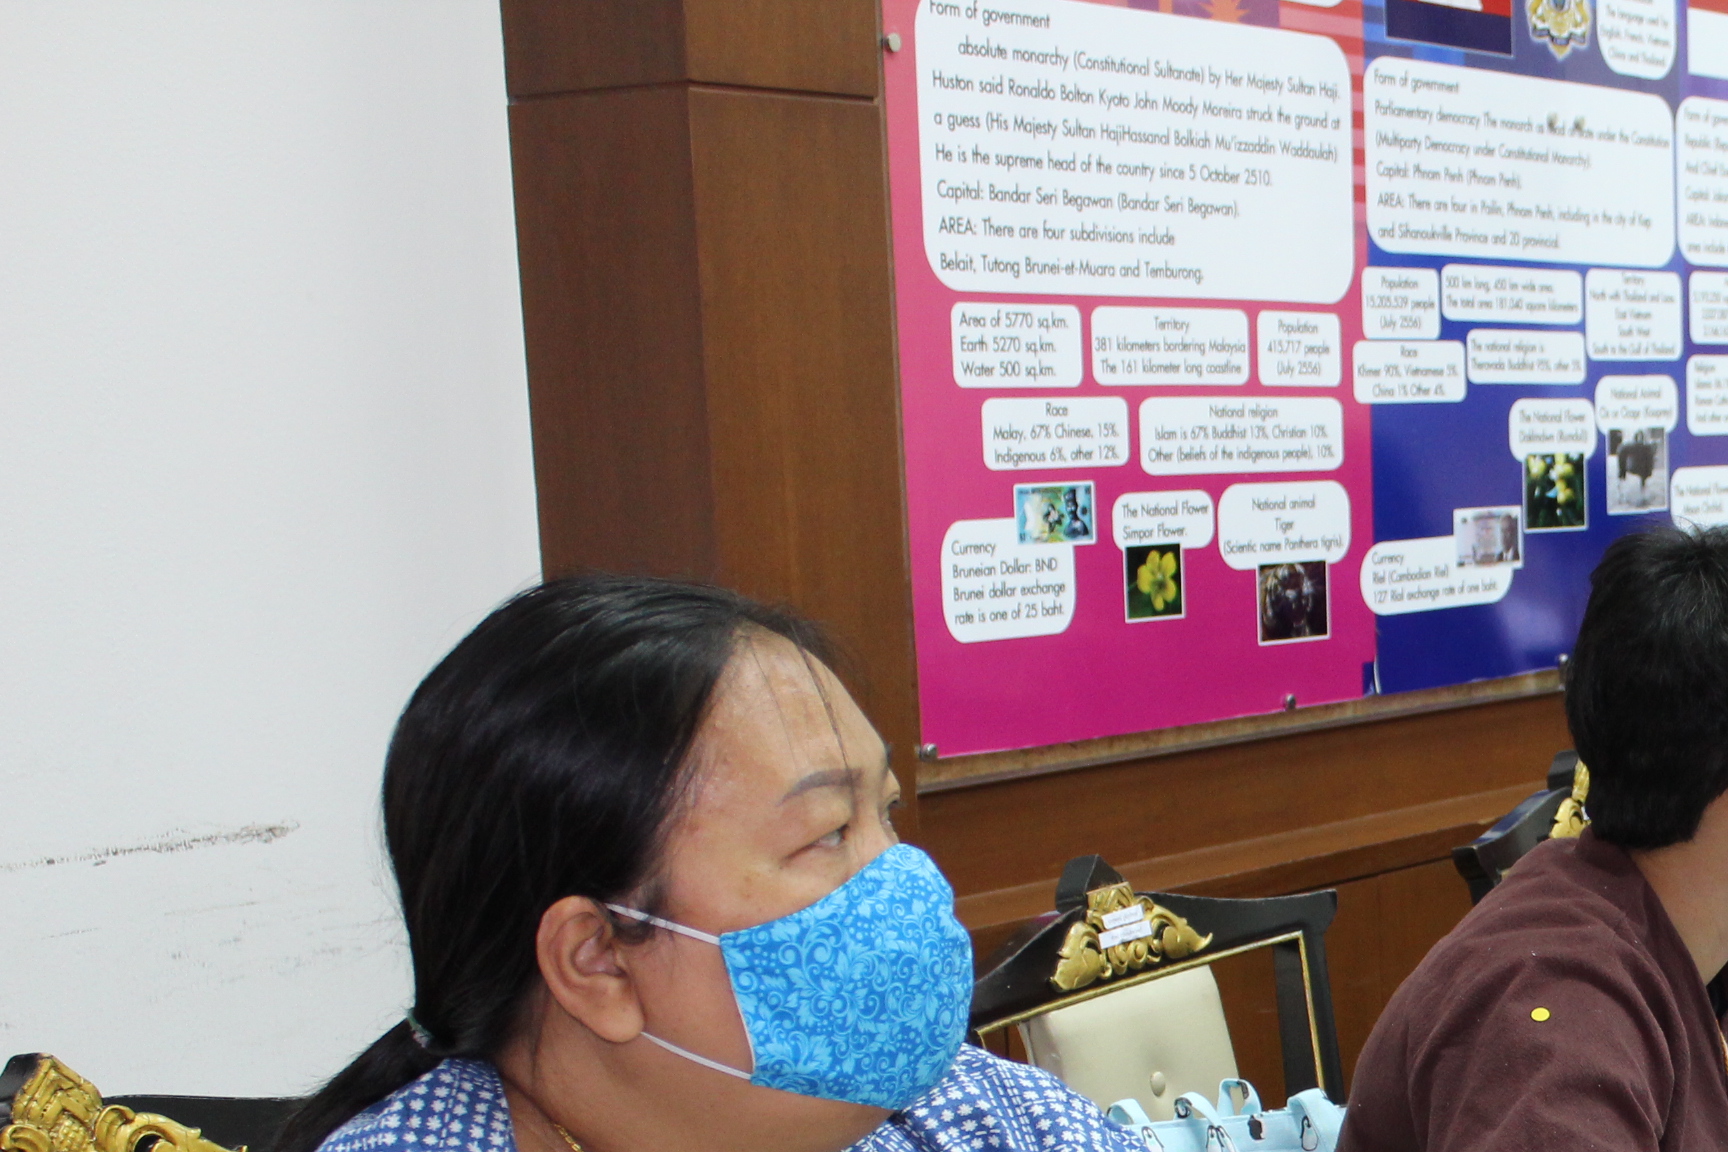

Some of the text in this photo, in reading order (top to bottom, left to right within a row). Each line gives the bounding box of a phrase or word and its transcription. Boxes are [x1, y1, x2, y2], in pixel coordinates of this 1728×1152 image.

[964, 0, 977, 19] of
[981, 8, 1050, 27] government
[957, 35, 1007, 59] absolute
[1011, 46, 1068, 70] monarchy
[1072, 50, 1150, 75] (Constitutional
[1153, 59, 1205, 83] Sultanate)
[1207, 65, 1221, 88] by
[1224, 69, 1242, 86] Her
[1245, 73, 1283, 94] Majesty
[1286, 76, 1316, 95] Sultan
[931, 69, 974, 90] Huston
[978, 74, 1004, 94] said
[1007, 77, 1056, 99] Ronaldo
[1133, 90, 1158, 109] John
[1161, 95, 1198, 117] Moody
[1201, 100, 1242, 119] Moreira
[1245, 104, 1273, 121] struck
[1276, 105, 1291, 124] the
[1294, 111, 1328, 131] ground
[1330, 116, 1340, 130] at
[933, 111, 942, 125] a
[946, 112, 980, 131] guess
[984, 110, 1008, 131] (His
[1012, 115, 1057, 139] Majesty
[1061, 117, 1096, 138] Sultan
[1173, 128, 1211, 148] Bolkiah
[934, 142, 953, 162] He
[956, 144, 967, 163] is
[970, 144, 990, 164] the
[994, 153, 1043, 170] supreme
[1046, 150, 1076, 171] head
[1079, 152, 1092, 172] of
[1094, 154, 1112, 174] the
[1115, 162, 1155, 181] country
[1158, 162, 1185, 179] since
[1188, 162, 1196, 180] 5
[1199, 163, 1240, 183] October
[936, 179, 984, 203] Capital:
[987, 182, 1031, 203] Bandar
[1035, 185, 1058, 204] Seri
[1061, 188, 1113, 211] Begawan
[1116, 191, 1159, 211] (Bandar
[1163, 194, 1184, 212] Seri
[938, 215, 1175, 245] AREA: There are four subdivisions include
[981, 253, 1020, 278] Tutong
[1118, 258, 1141, 277] and
[958, 311, 1069, 331] Area of 5770 sq.km.
[959, 335, 1057, 356] Earth 5270 sq.km.
[961, 359, 1057, 380] Water 500 sq.km.
[950, 539, 996, 556] Currency
[951, 563, 996, 578] Bruneian
[1034, 556, 1058, 572] BND
[952, 579, 1065, 601] Brunei dollar exchange
[954, 610, 974, 624] rate
[977, 608, 986, 622] is
[988, 609, 1008, 621] one
[1010, 602, 1021, 619] of
[1024, 602, 1038, 618] 25
